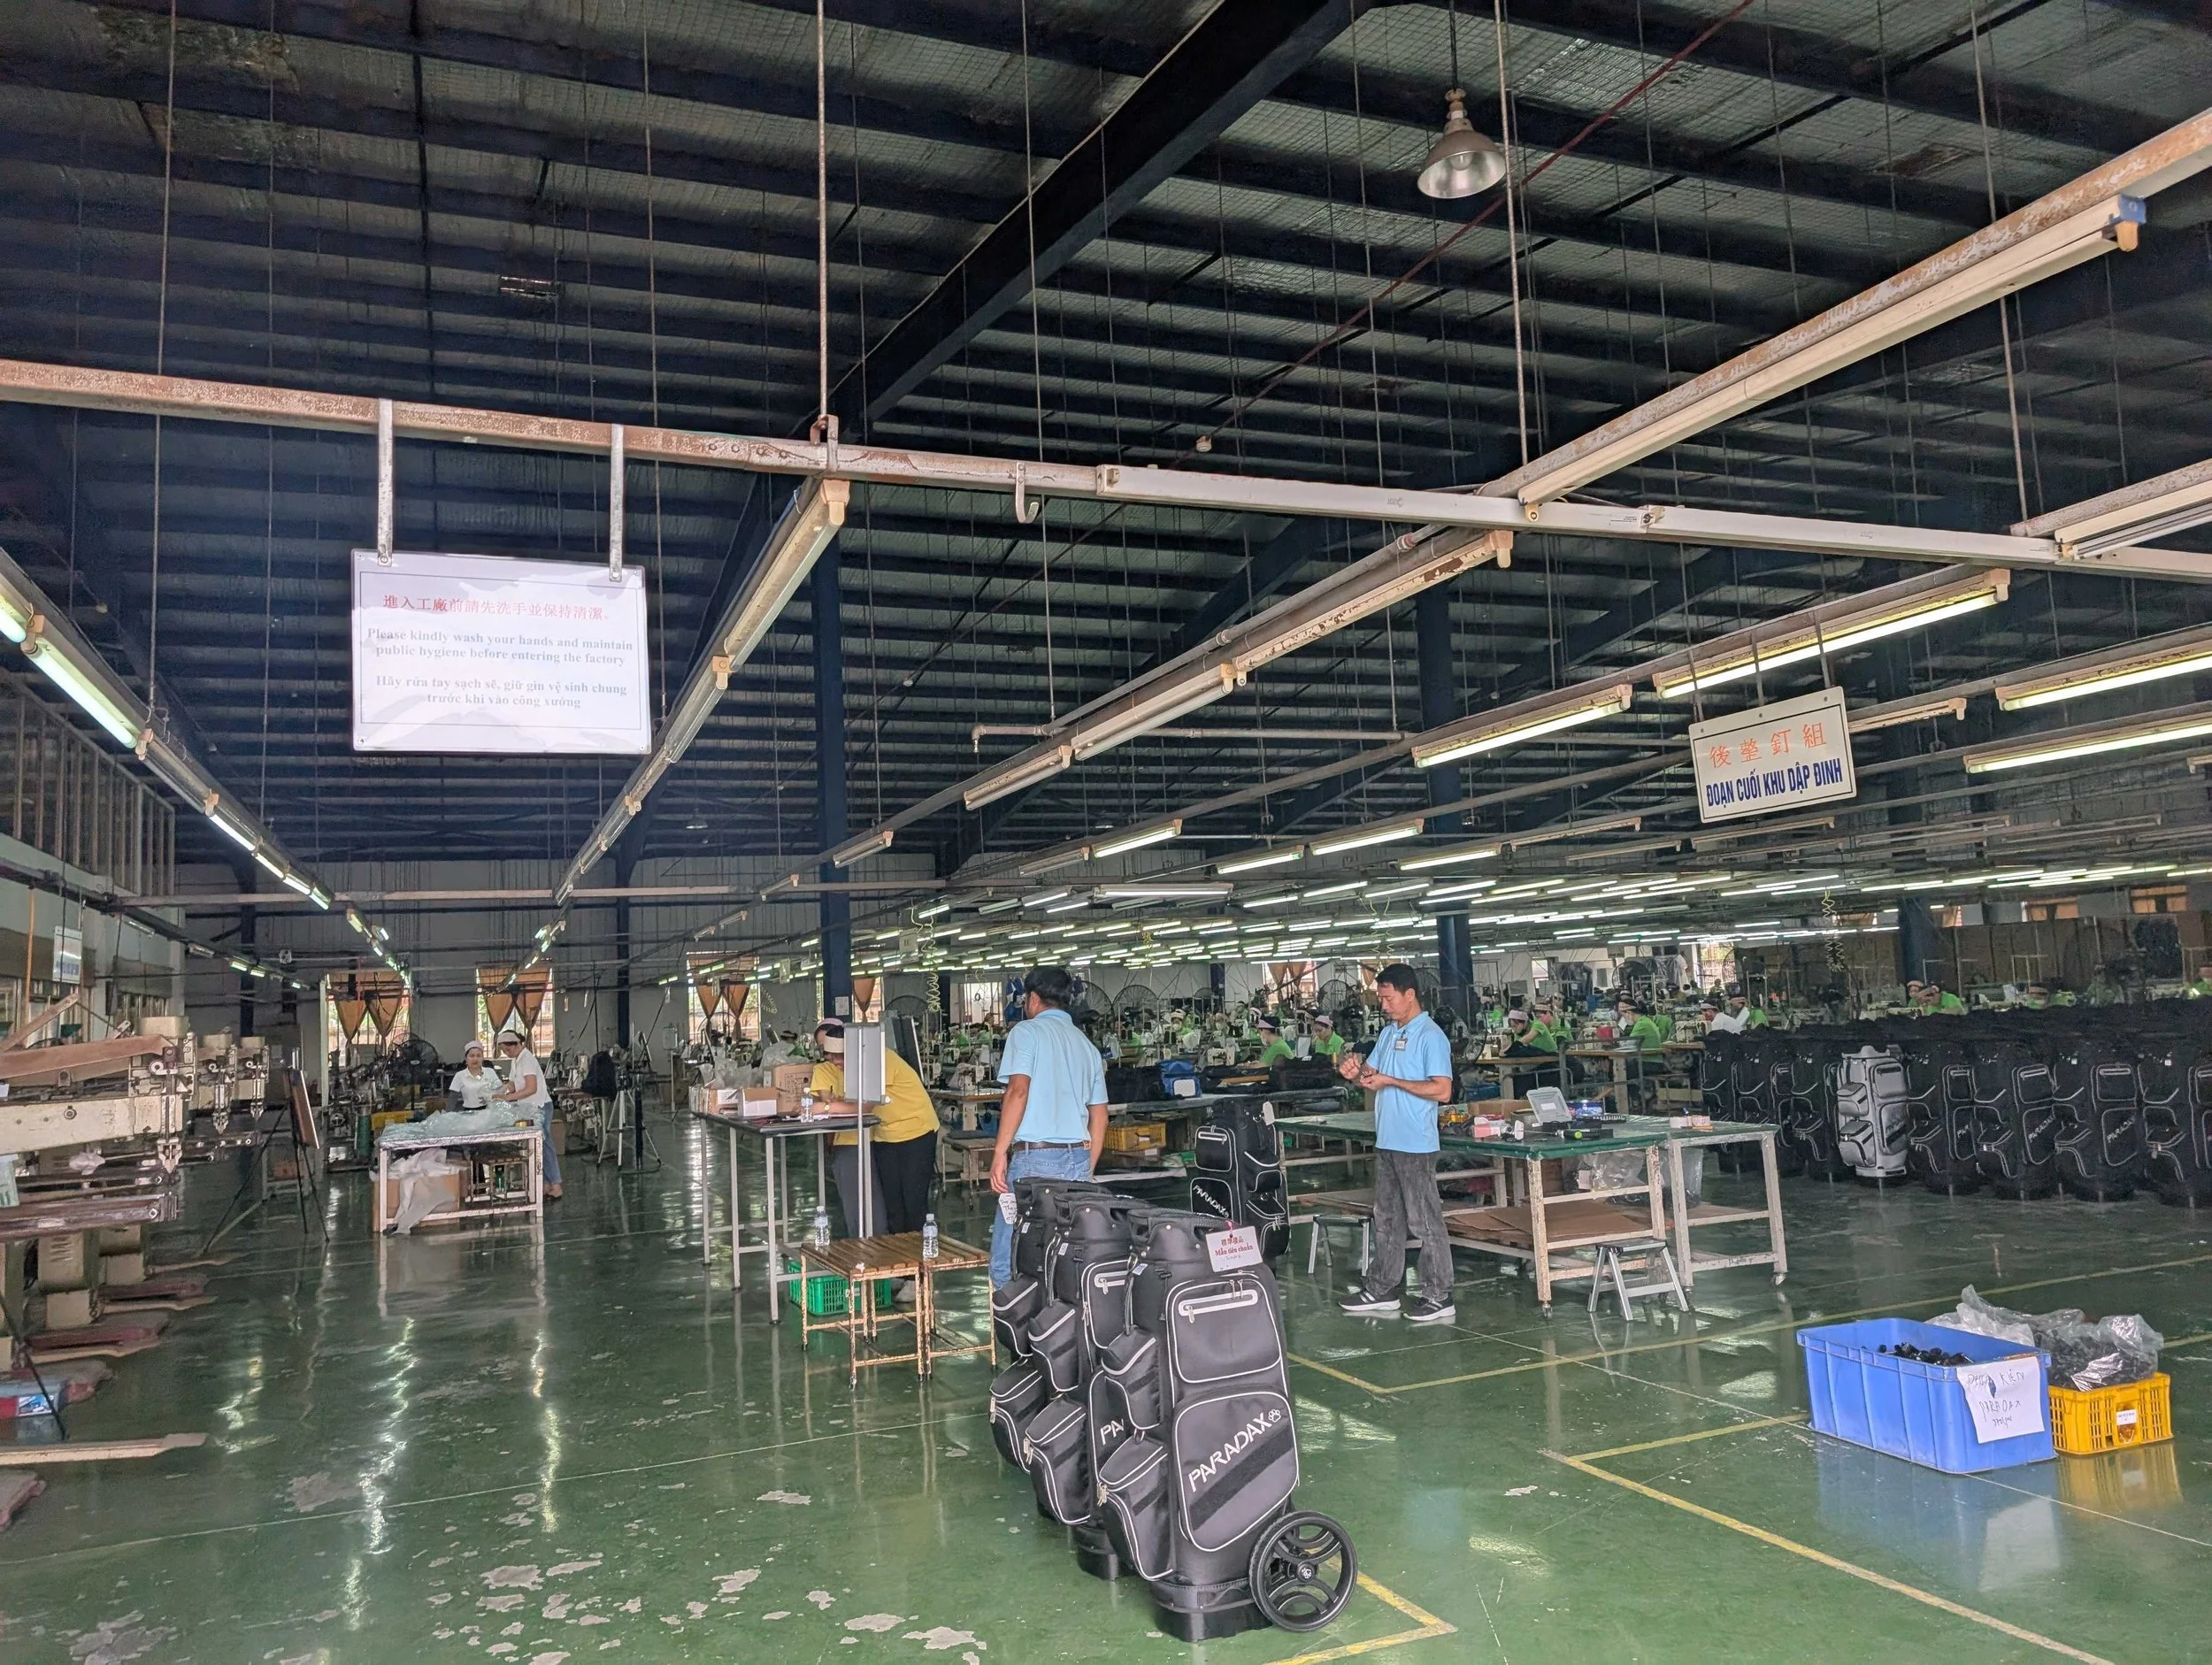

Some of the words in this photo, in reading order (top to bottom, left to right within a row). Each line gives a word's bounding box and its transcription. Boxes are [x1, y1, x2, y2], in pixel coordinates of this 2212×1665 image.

[367, 628, 407, 641] Please
[410, 630, 449, 644] kindly
[453, 633, 484, 643] wash
[487, 635, 516, 646] your
[518, 635, 554, 647] hands
[557, 638, 579, 648] and
[581, 640, 634, 651] maintain
[375, 645, 416, 657] public
[419, 646, 467, 659] hygiene
[470, 648, 509, 660] before
[511, 651, 561, 664] entering
[564, 652, 581, 664] the
[585, 653, 626, 668] factory
[376, 675, 402, 690] Hãy
[432, 679, 451, 690] tay
[455, 679, 481, 691] sạch
[565, 683, 588, 694] sinh
[592, 683, 628, 697] chung
[465, 694, 485, 705] khi
[512, 696, 541, 709] công
[1709, 722, 1827, 768] 後整釘組
[1705, 779, 1735, 809] ĐOẠN
[1736, 767, 1762, 802] CUỐI
[1763, 769, 1786, 797] KHU
[1787, 761, 1810, 794] DẬP
[1812, 757, 1844, 788] ĐINH
[1192, 1184, 1228, 1215] PARADAX
[1100, 1418, 1125, 1445] PA
[1187, 1412, 1272, 1493] PARADAX
